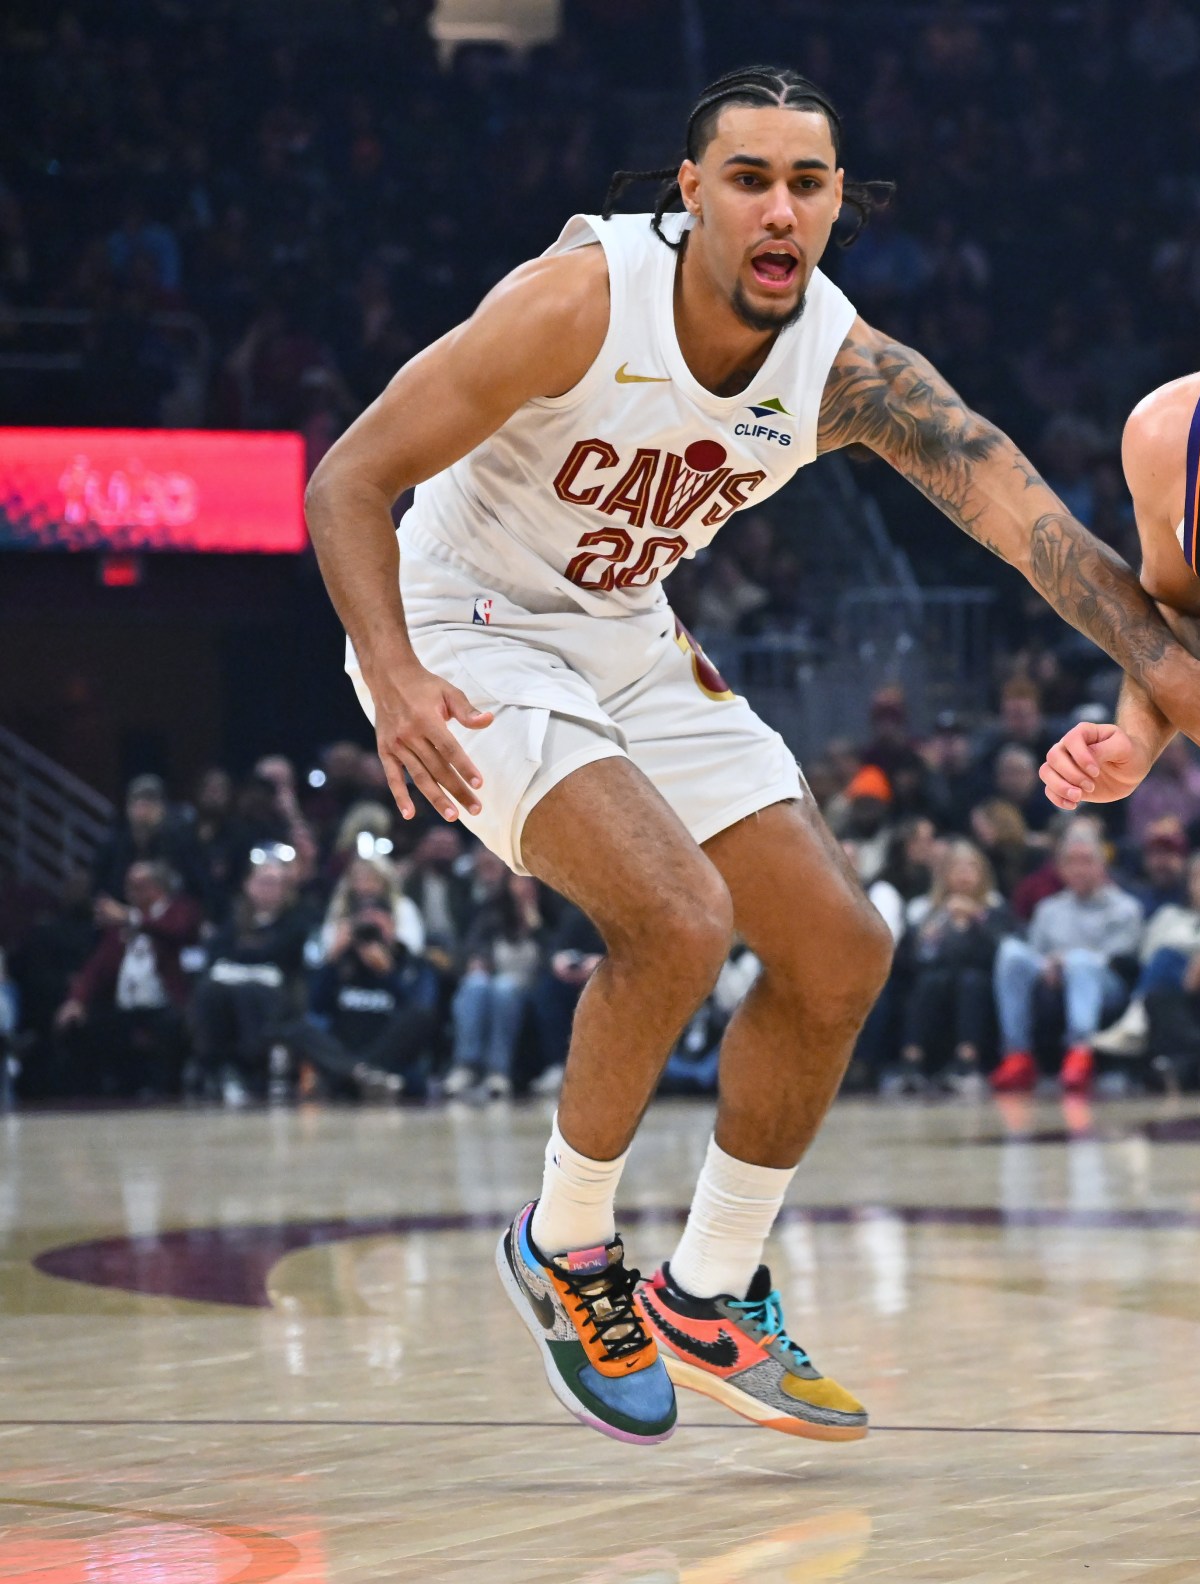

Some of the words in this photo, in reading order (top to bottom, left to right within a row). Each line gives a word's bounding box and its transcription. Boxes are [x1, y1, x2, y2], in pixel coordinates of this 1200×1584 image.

[734, 423, 792, 446] CLIFFS
[553, 438, 767, 530] CAVS
[563, 527, 689, 592] 20
